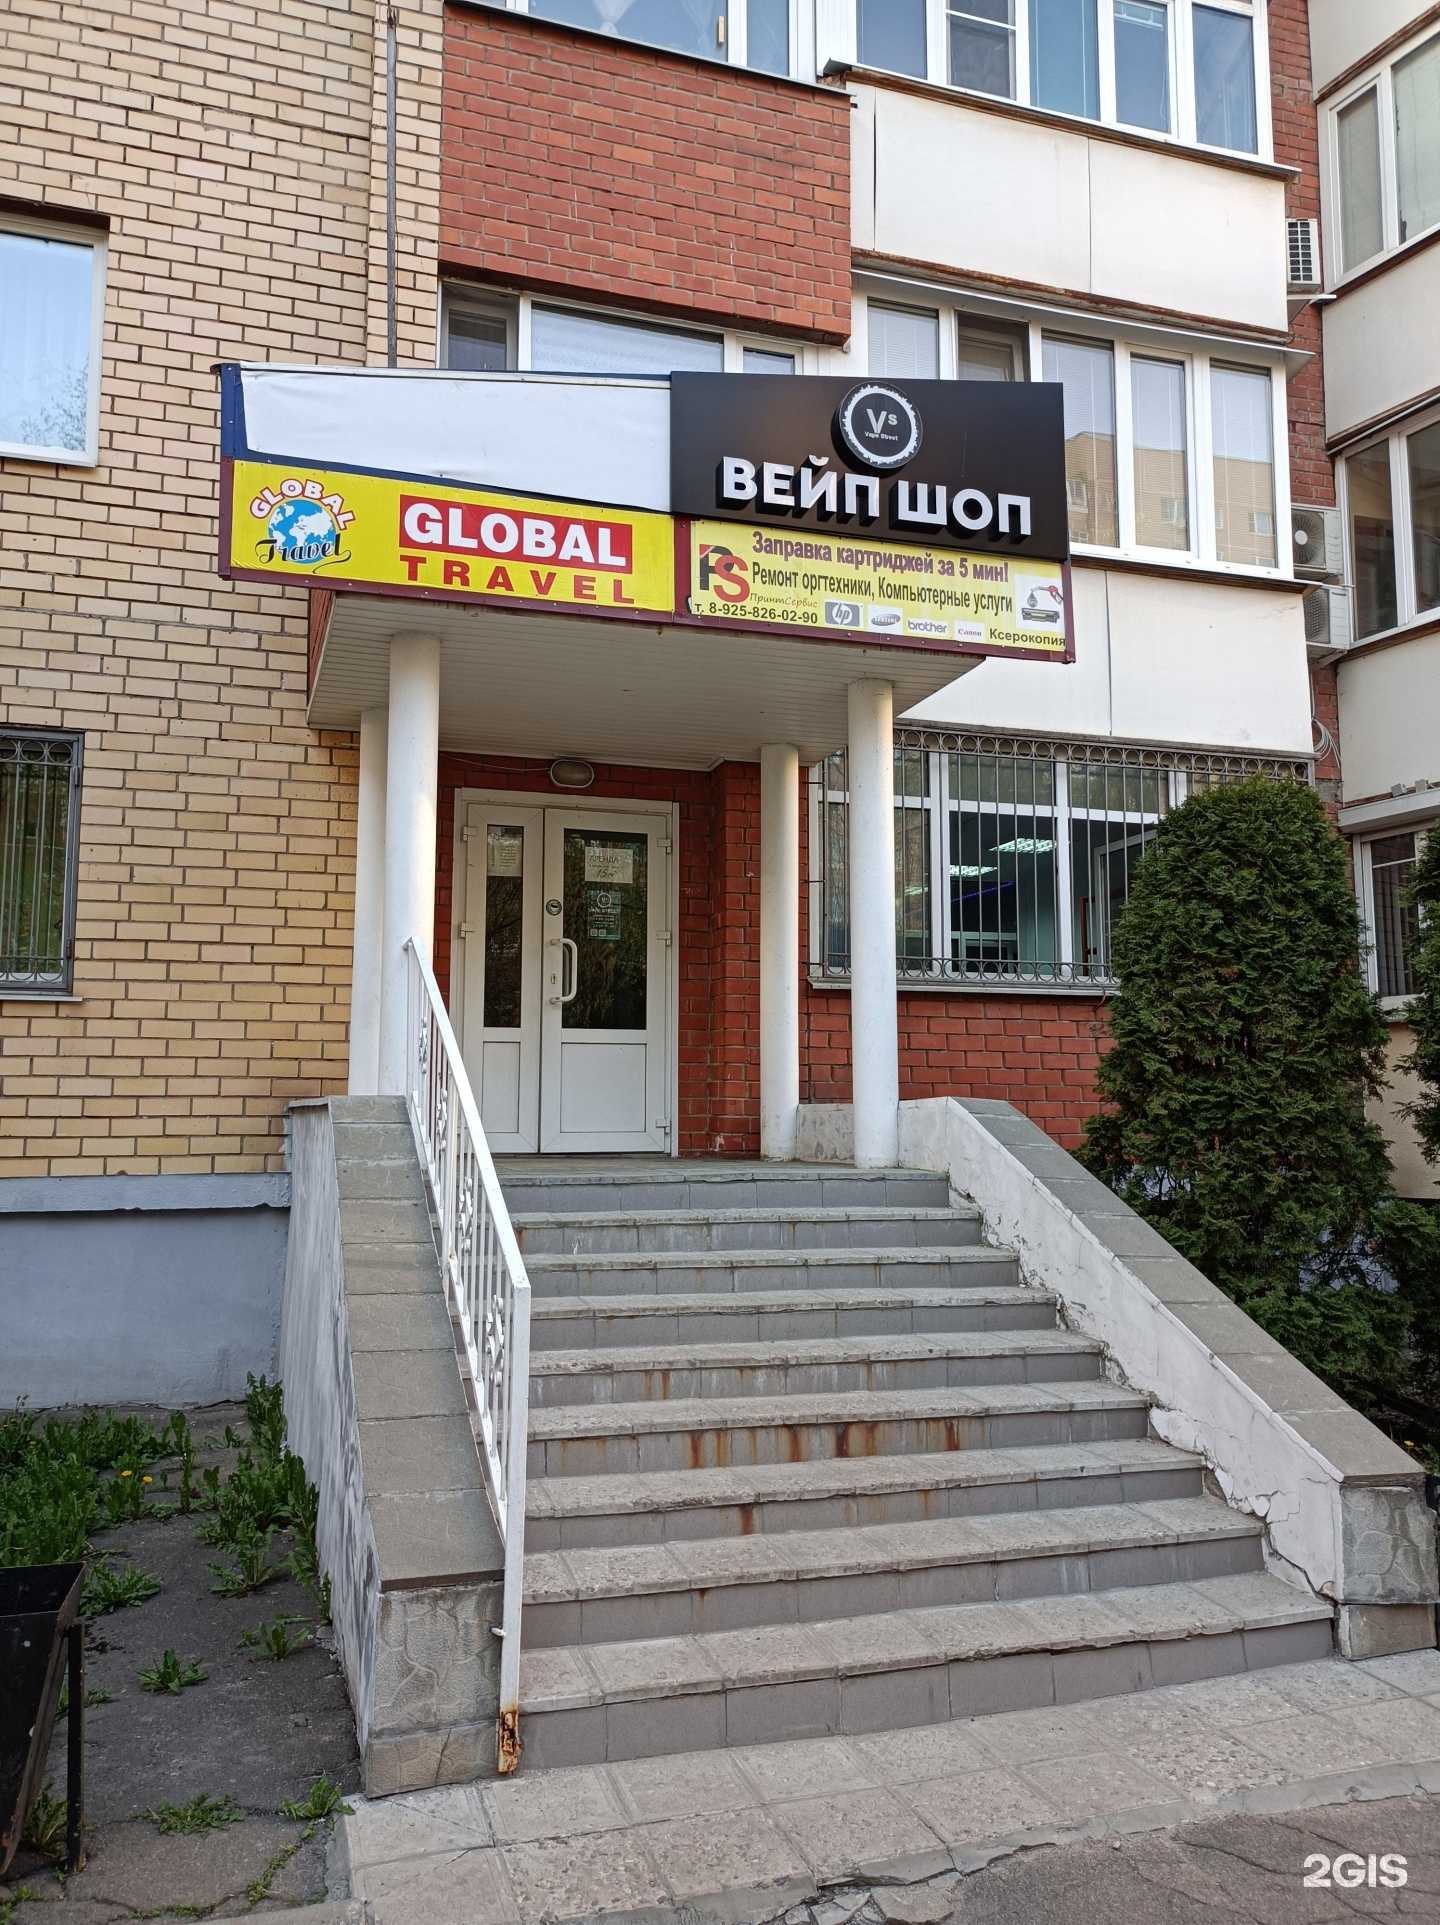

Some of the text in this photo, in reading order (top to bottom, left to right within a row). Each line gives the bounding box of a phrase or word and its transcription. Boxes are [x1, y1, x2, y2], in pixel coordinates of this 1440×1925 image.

[249, 478, 357, 530] GLOBAL
[722, 455, 1032, 536] ВЕЙП ШОП
[254, 533, 352, 574] Travel
[403, 502, 627, 567] GLOBAL
[752, 530, 1009, 583] Заправка картриджей за 5 мин!
[400, 554, 635, 605] TRAVEL
[752, 561, 1012, 617] Ремонт оргтехники, Компьютерные услуги
[709, 602, 818, 624] 8-925-826-02-90
[907, 619, 948, 634] brother
[989, 628, 1066, 647] Ксерокопия
